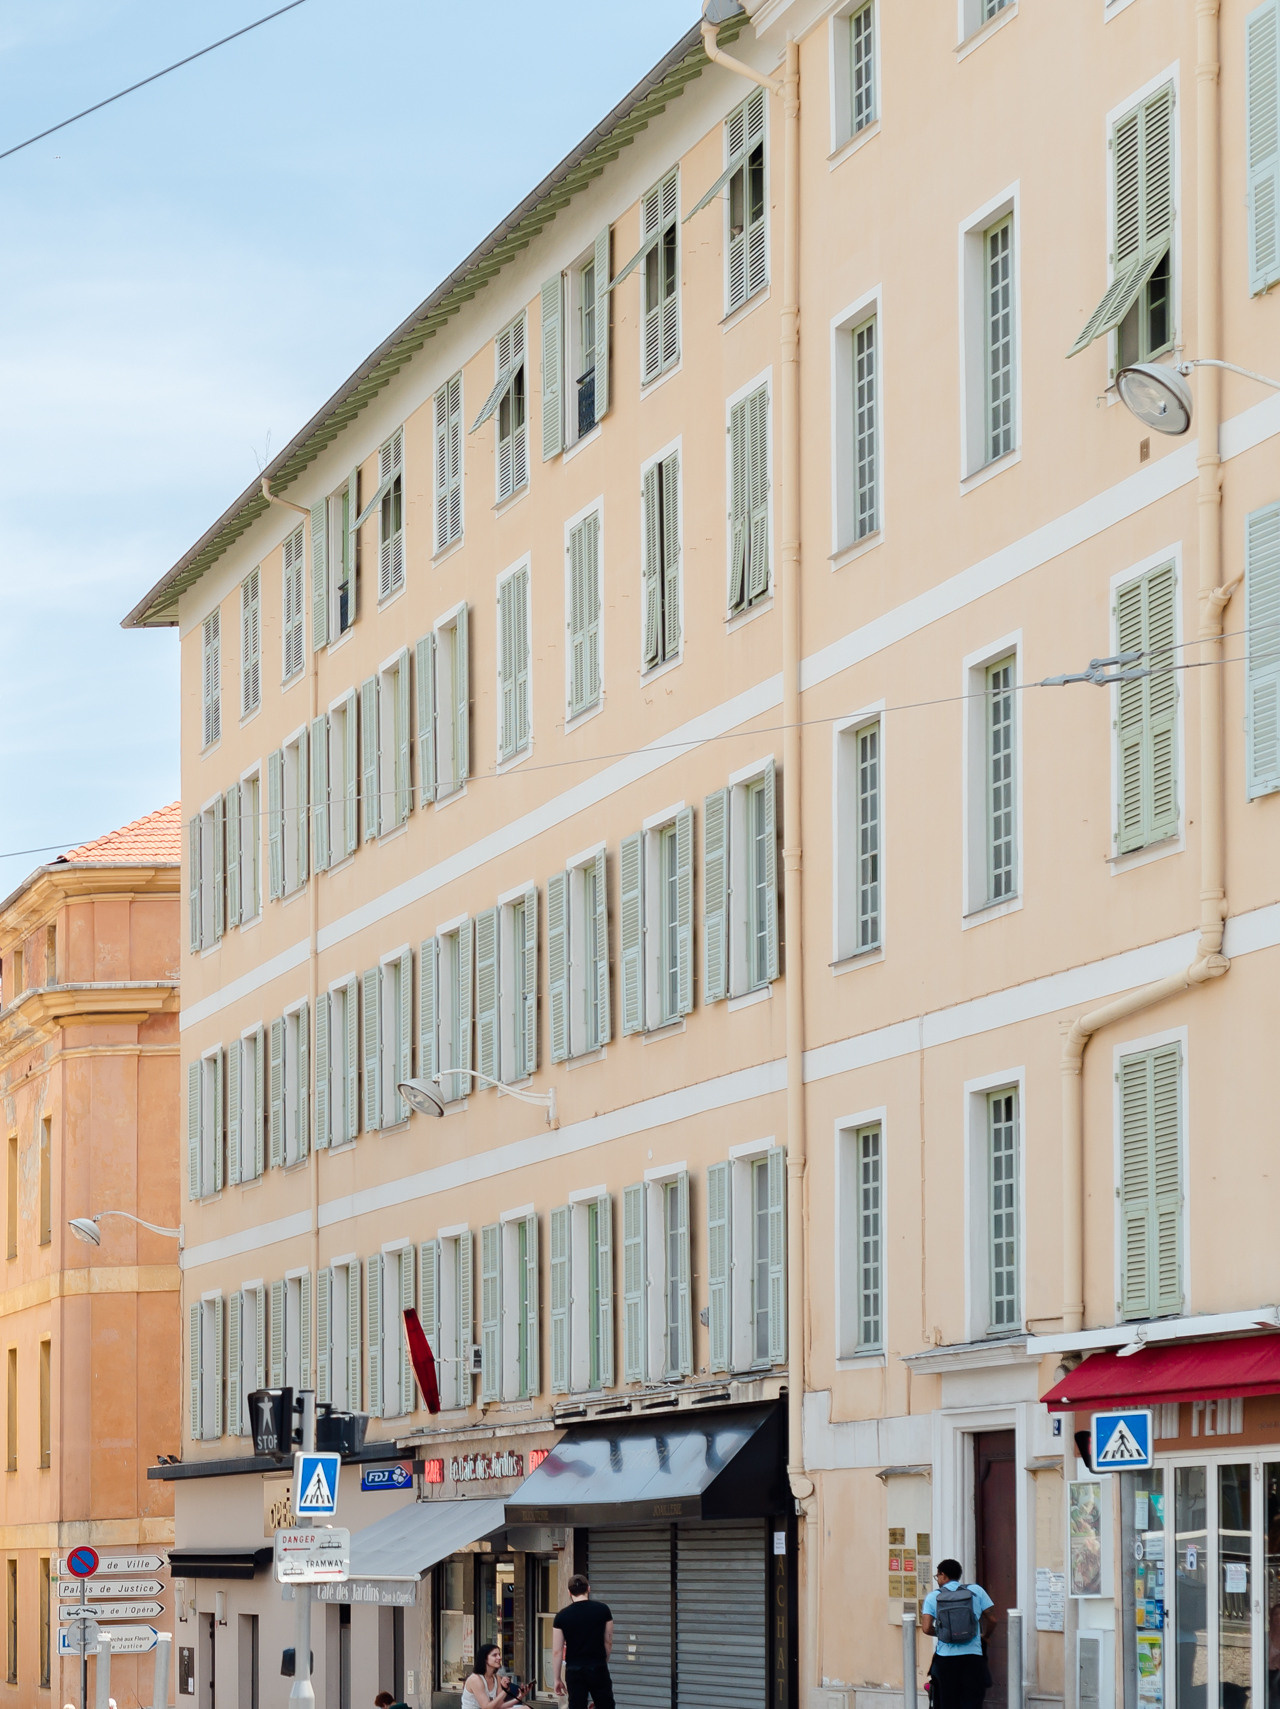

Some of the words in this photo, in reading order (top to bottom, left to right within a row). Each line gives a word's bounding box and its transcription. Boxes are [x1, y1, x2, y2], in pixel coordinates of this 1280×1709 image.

[368, 1472, 389, 1482] FDJ
[282, 1536, 315, 1544] DANGER
[107, 1561, 118, 1569] de
[126, 1560, 150, 1569] Ville
[305, 1560, 344, 1568] TRAMWAY
[63, 1585, 93, 1594] Palis
[100, 1585, 111, 1593] de
[118, 1583, 154, 1593] Justice
[317, 1582, 334, 1600] Café
[336, 1583, 349, 1600] des
[351, 1583, 380, 1602] Jardins
[125, 1606, 154, 1615] l'Opéra
[776, 1554, 785, 1701] ACHAT
